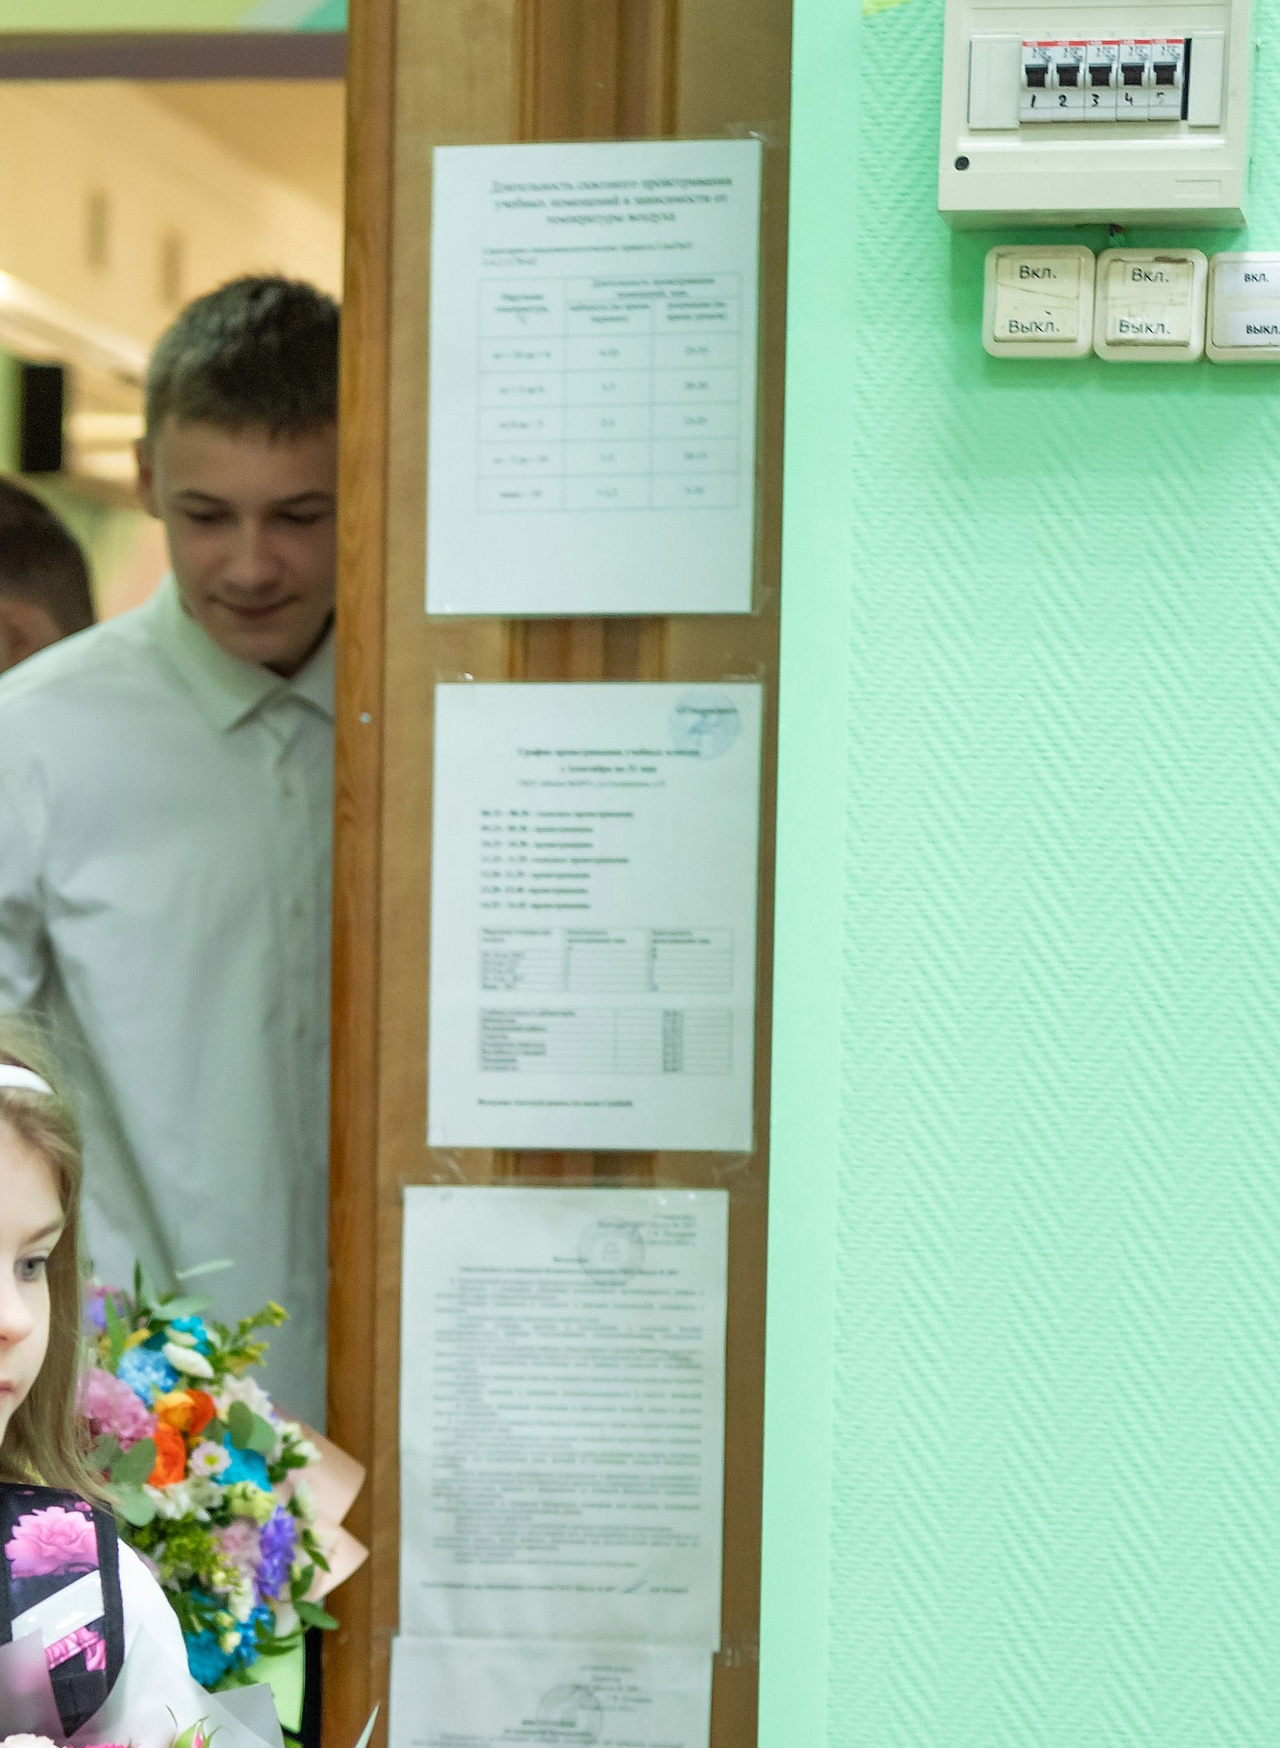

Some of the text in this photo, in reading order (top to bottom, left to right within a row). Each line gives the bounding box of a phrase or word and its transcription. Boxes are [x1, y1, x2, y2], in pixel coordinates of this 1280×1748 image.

[1030, 93, 1037, 108] 1
[1058, 93, 1068, 108] 2
[1091, 93, 1100, 108] 3
[1124, 91, 1134, 106] 4
[1019, 265, 1057, 280] Вкл.
[1131, 267, 1170, 283] Вкл.
[1008, 319, 1061, 334] Выкл.
[1118, 318, 1172, 335] Выкл.
